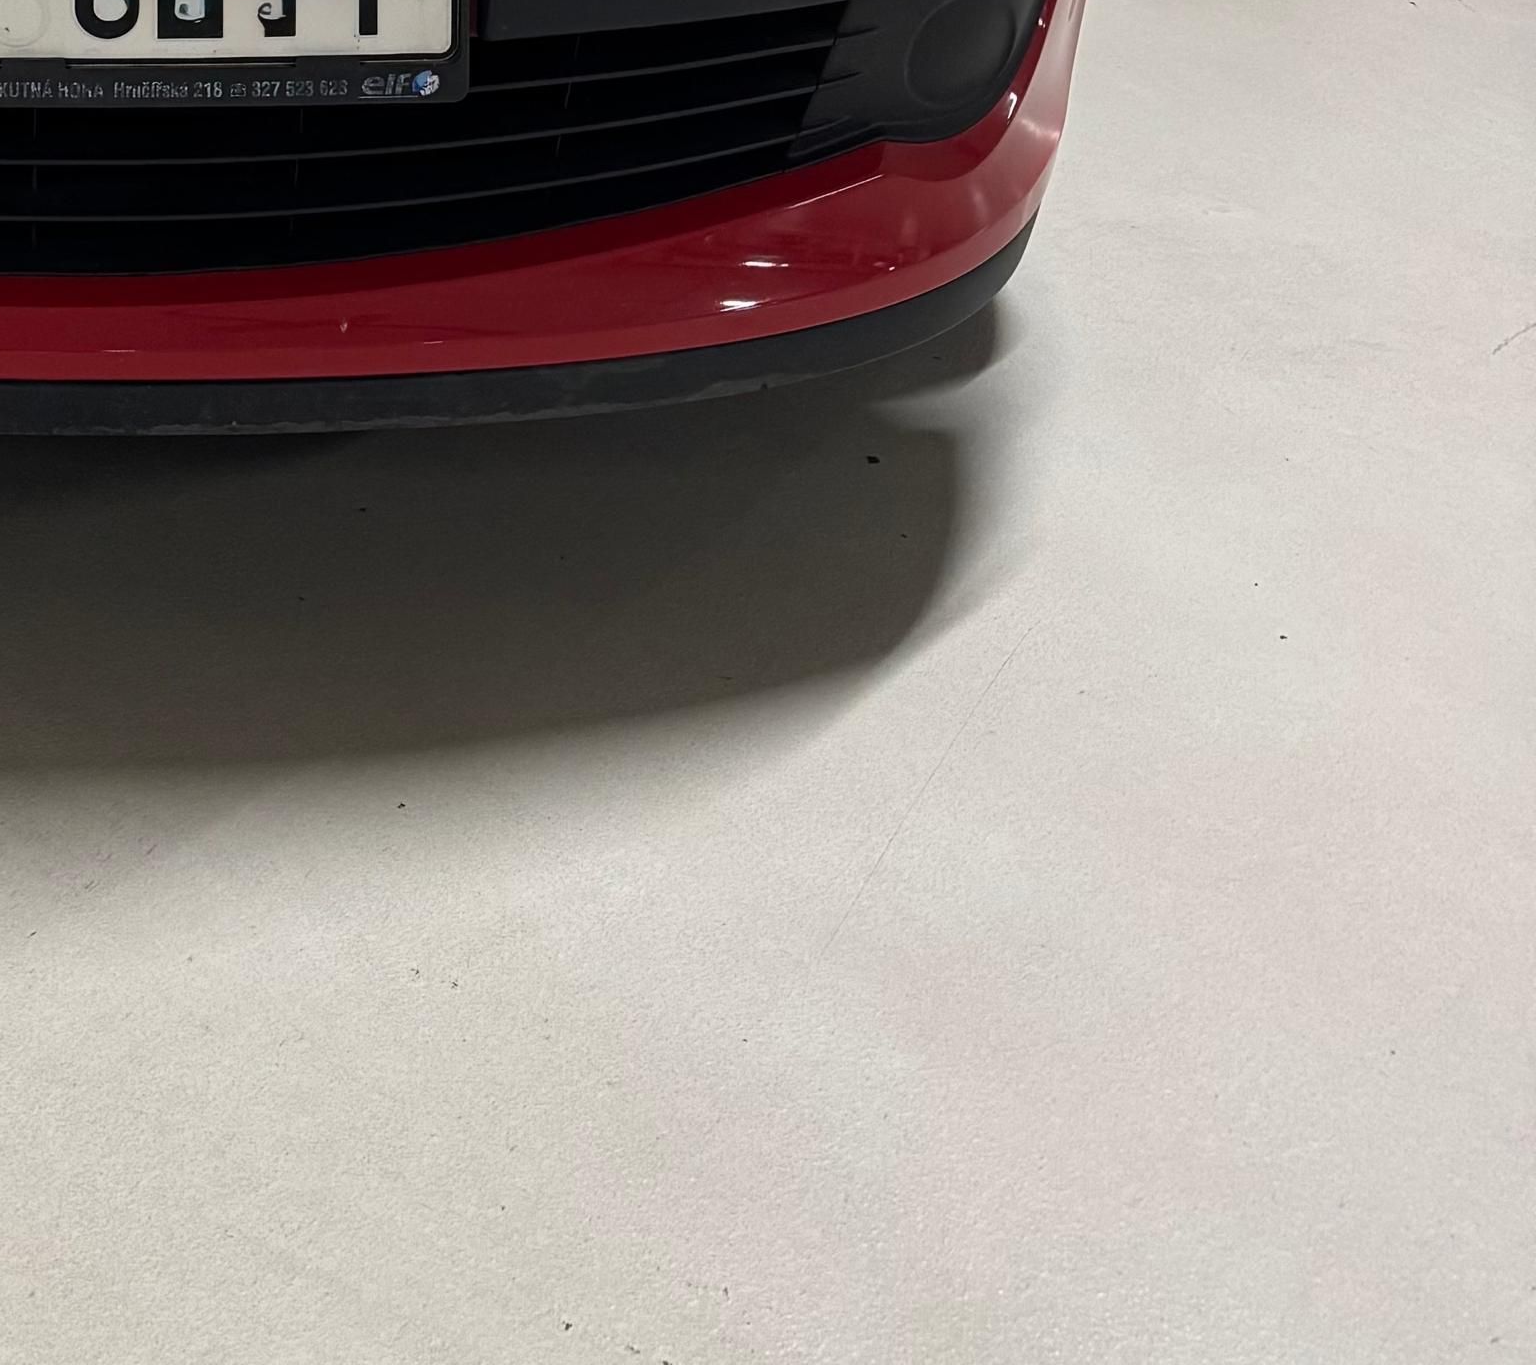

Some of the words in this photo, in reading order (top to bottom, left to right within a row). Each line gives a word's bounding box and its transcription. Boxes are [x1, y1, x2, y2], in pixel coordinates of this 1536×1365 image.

[193, 81, 223, 98] 218
[251, 80, 281, 98] 327
[285, 79, 314, 97] 523
[361, 73, 412, 96] elf
